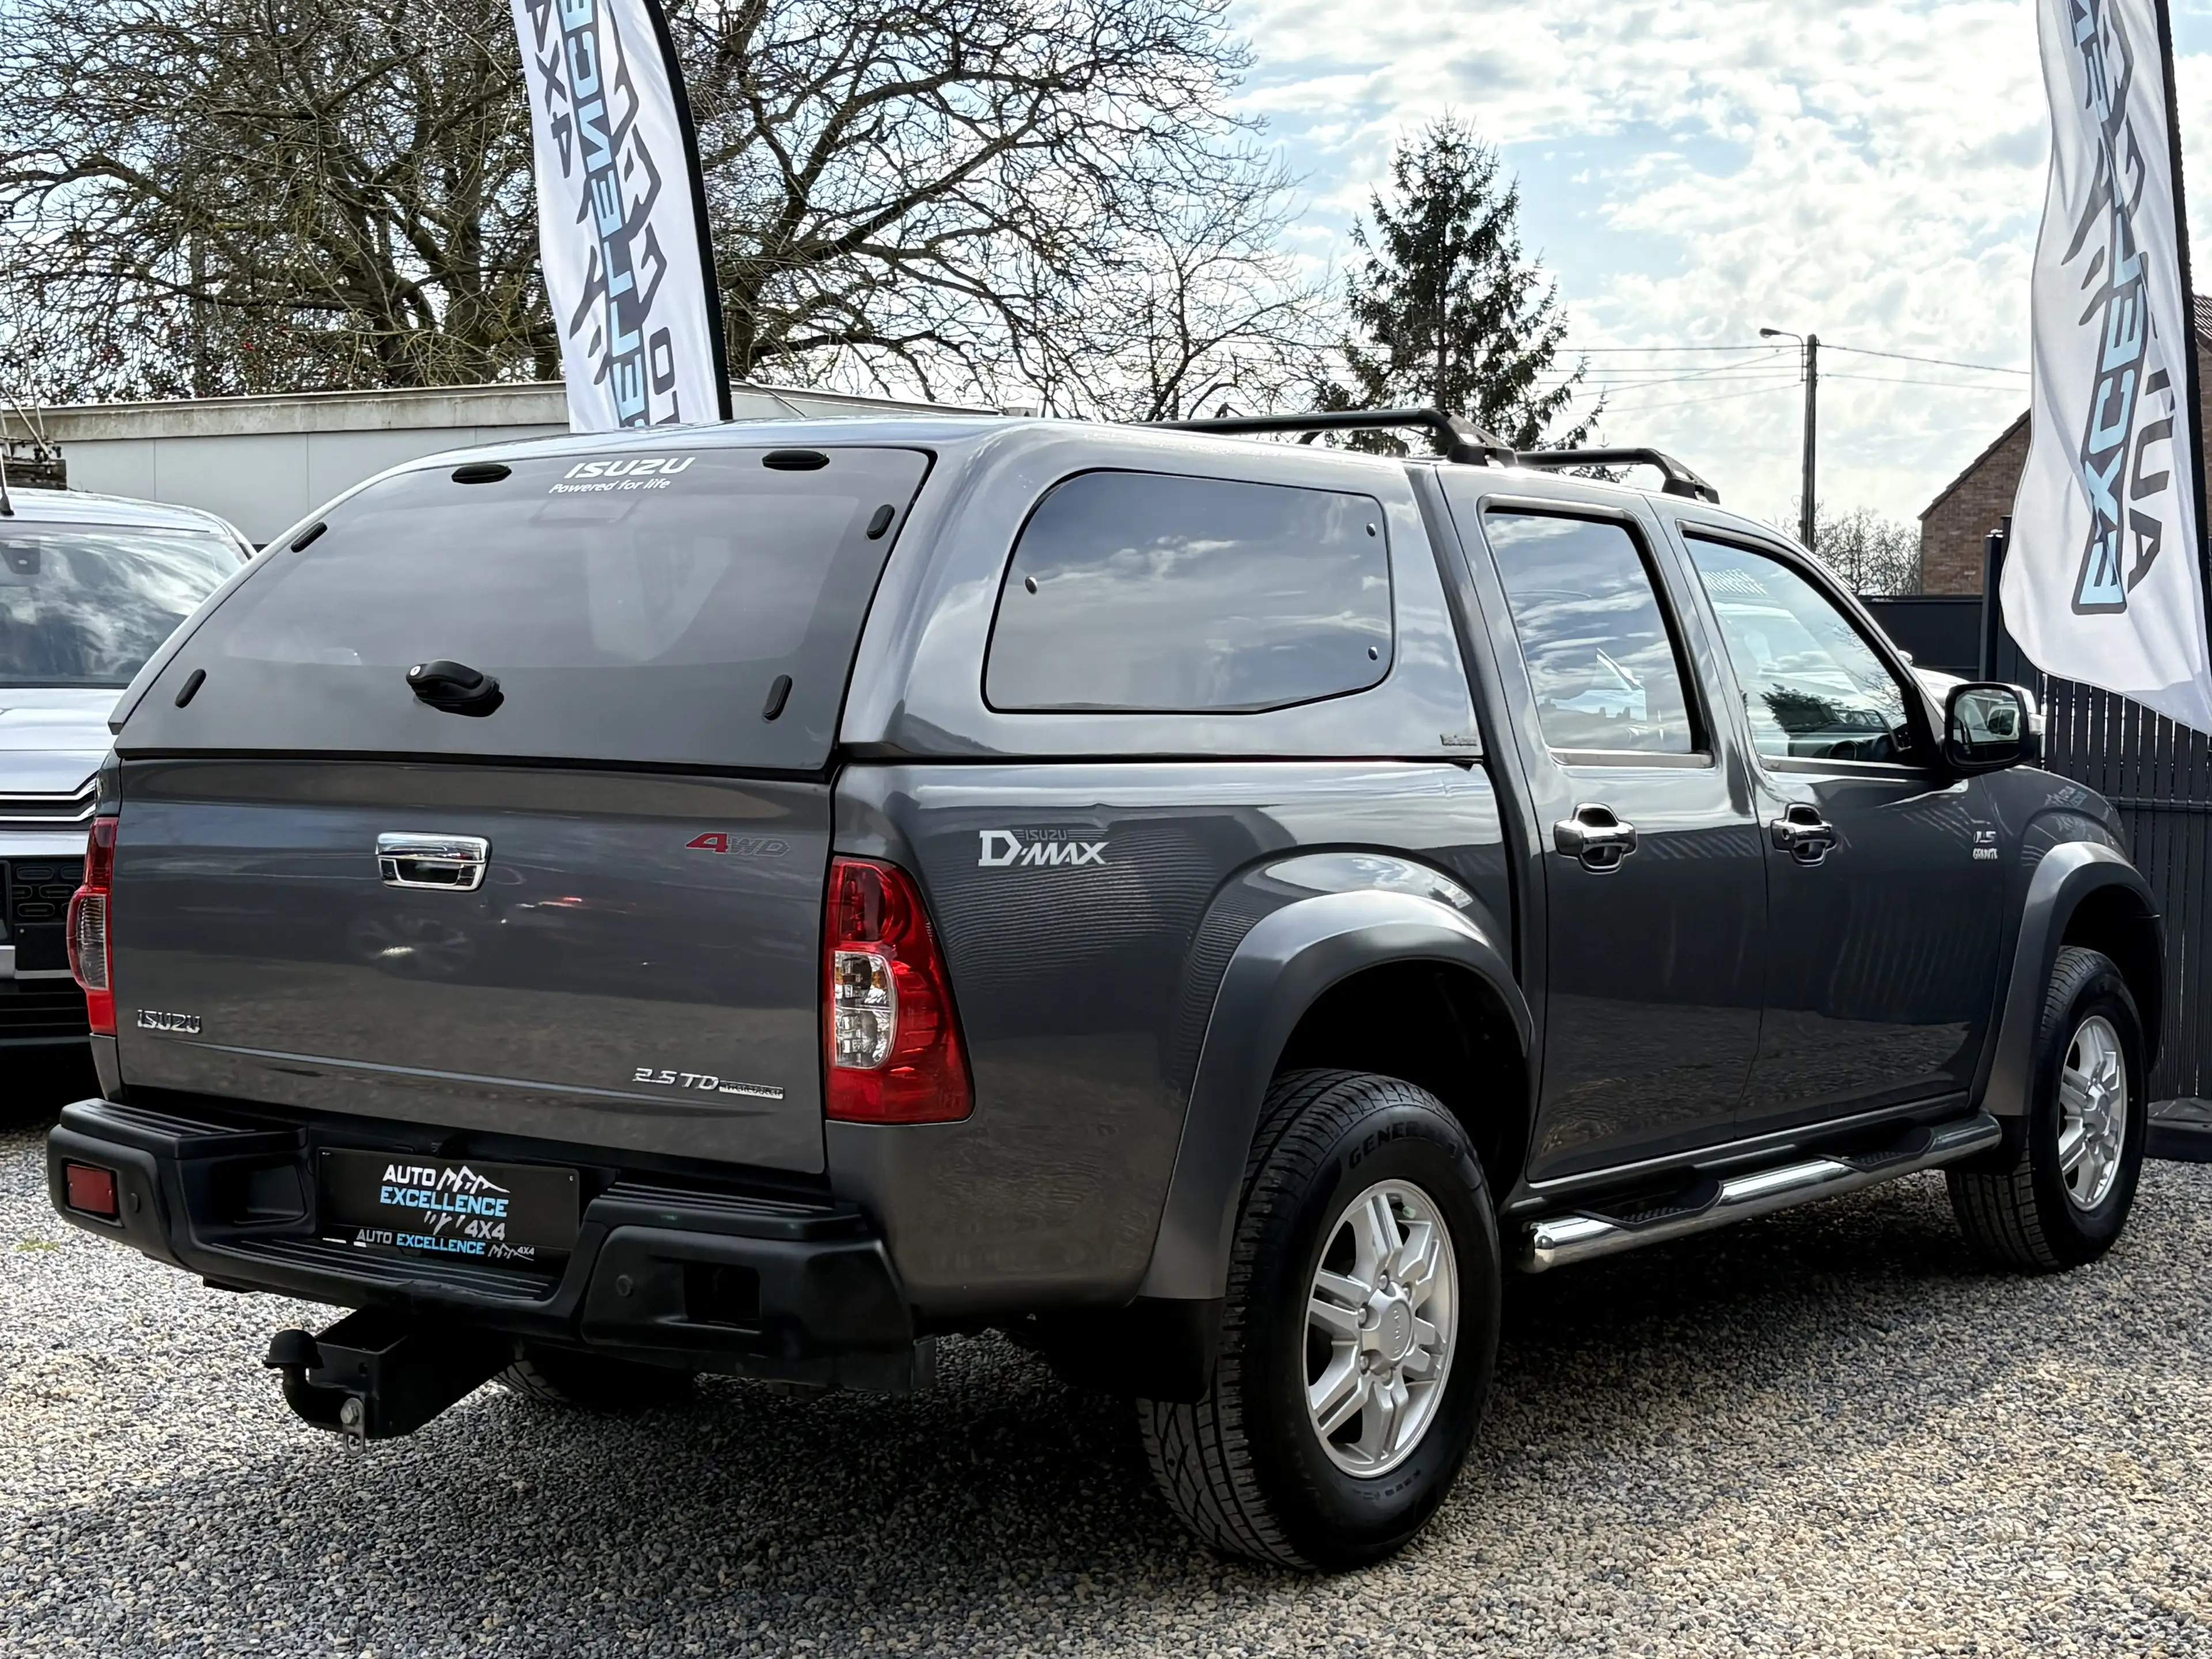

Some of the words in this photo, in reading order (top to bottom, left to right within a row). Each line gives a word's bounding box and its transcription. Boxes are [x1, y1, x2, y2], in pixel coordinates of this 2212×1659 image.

[564, 457, 695, 479] ISUZU
[548, 480, 619, 494] Powered
[618, 479, 644, 490] for
[643, 478, 671, 490] life
[685, 831, 790, 857] 4WD
[1024, 829, 1067, 841] ISUZU
[137, 1009, 201, 1034] ISUZU
[382, 1164, 436, 1187] AUTO
[380, 1185, 509, 1217] EXCELLENCE
[464, 1219, 505, 1241] 4X4
[356, 1229, 392, 1244] AUTO
[396, 1233, 486, 1255] EXCELLENCE
[517, 1246, 535, 1255] 4X4
